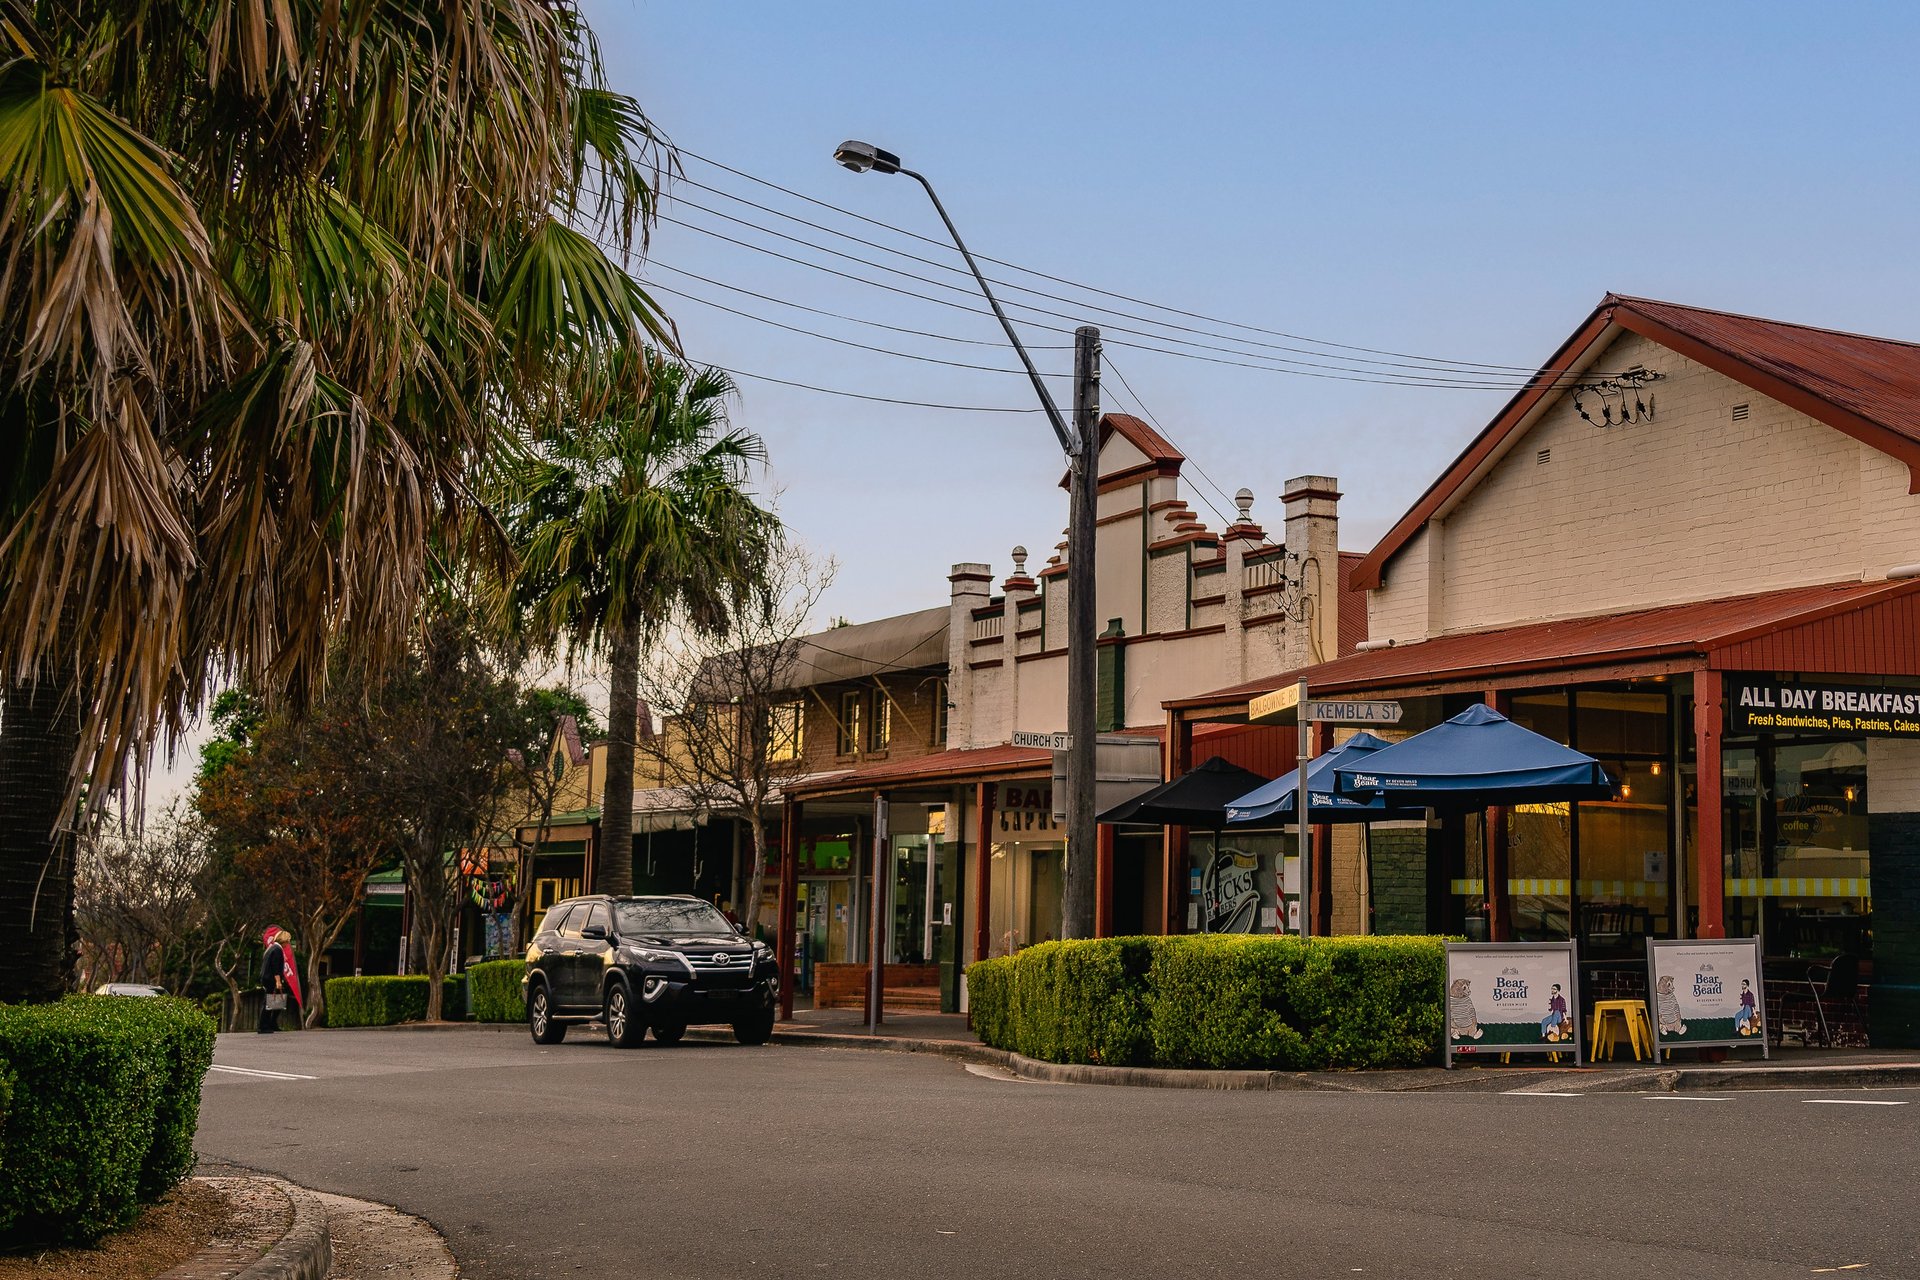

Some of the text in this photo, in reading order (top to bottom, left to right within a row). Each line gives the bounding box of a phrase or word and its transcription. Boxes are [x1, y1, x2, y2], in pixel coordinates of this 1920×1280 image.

[1251, 688, 1298, 716] BALGOWNIE RD
[1739, 686, 1920, 715] ALL DAY BREAKFAST
[1316, 703, 1398, 720] KEMBLA ST
[1748, 713, 1920, 733] Fresh Sandwiches, Pies, Pastries, Cakes
[1014, 733, 1065, 748] CHURCH ST
[1782, 819, 1809, 831] coffee
[1496, 976, 1525, 989] Bear
[1695, 973, 1720, 984] Bear
[1492, 986, 1528, 1001] Beard
[1693, 982, 1723, 997] Beard
